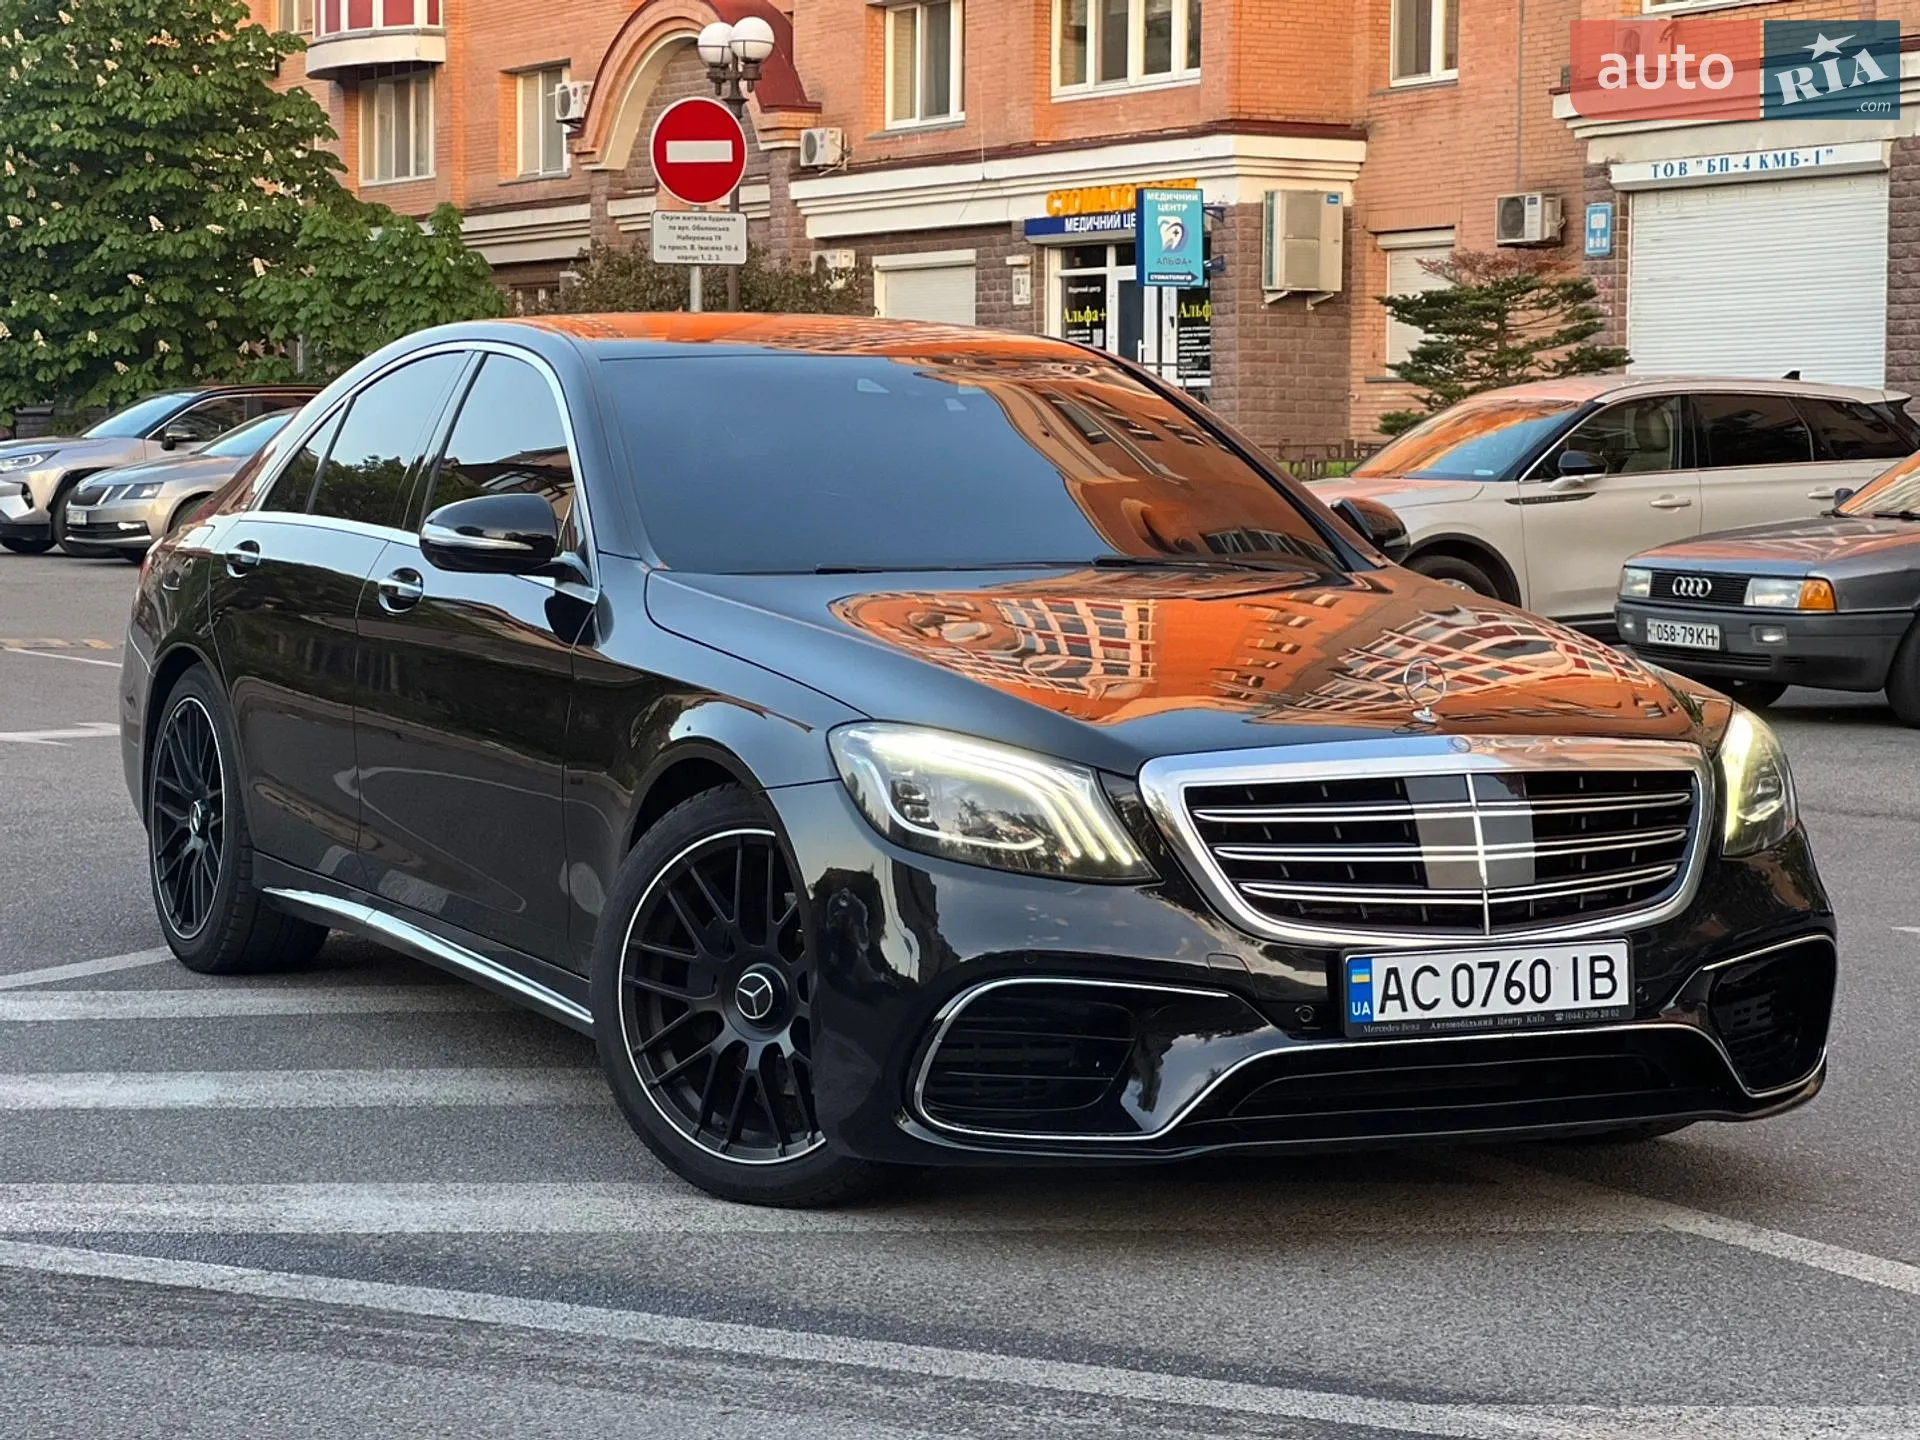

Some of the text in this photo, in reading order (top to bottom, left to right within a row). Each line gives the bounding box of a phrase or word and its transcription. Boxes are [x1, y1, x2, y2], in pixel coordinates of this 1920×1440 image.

[1650, 161, 1688, 178] ТОВ
[1146, 192, 1199, 202] МЕДИЧНИЙ
[1157, 203, 1188, 213] ЦЕНТР
[1064, 210, 1122, 233] МЕДИЧНИЙ
[1063, 305, 1107, 327] Альфа+
[1179, 300, 1212, 323] Альф
[1378, 954, 1618, 1014] AC 0760 IB
[1352, 1001, 1371, 1016] UA
